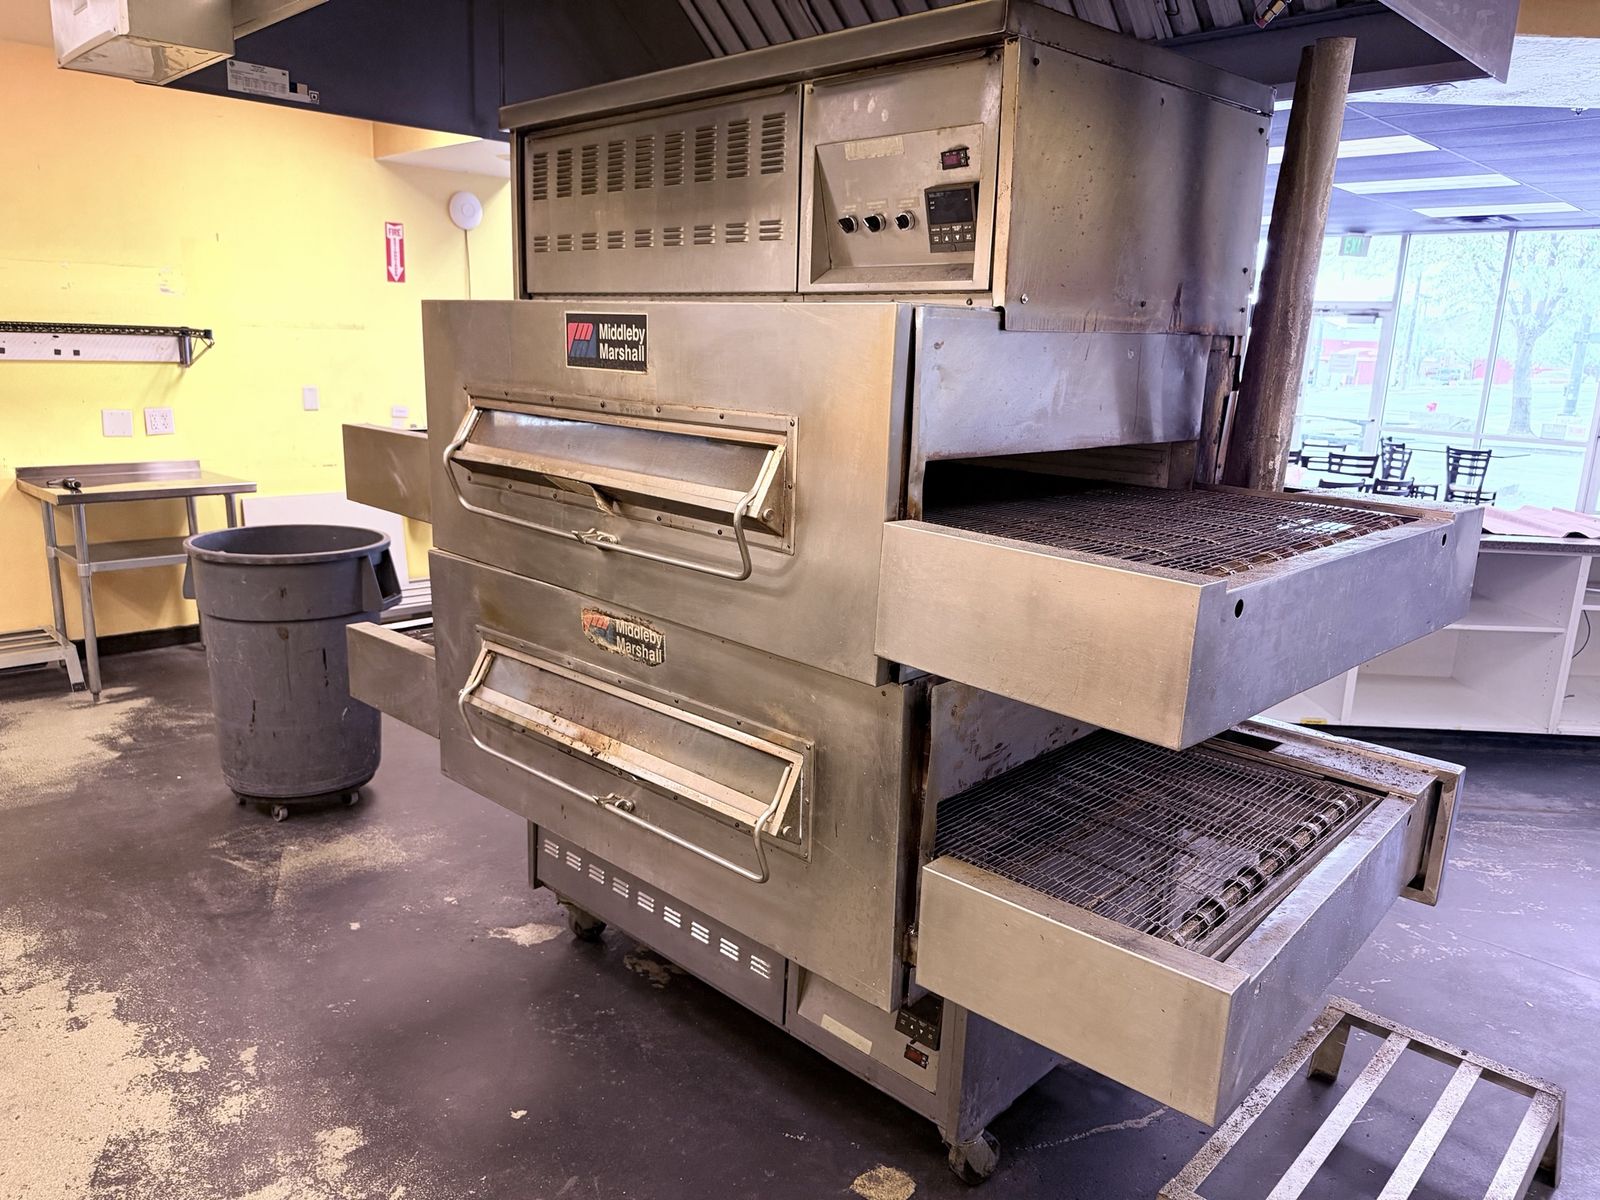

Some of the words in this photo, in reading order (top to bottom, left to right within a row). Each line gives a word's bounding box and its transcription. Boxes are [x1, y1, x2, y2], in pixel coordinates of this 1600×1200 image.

[599, 322, 645, 345] Middleby
[599, 343, 645, 362] Marshall
[615, 619, 663, 648] Middleby
[616, 636, 662, 663] Marshall
